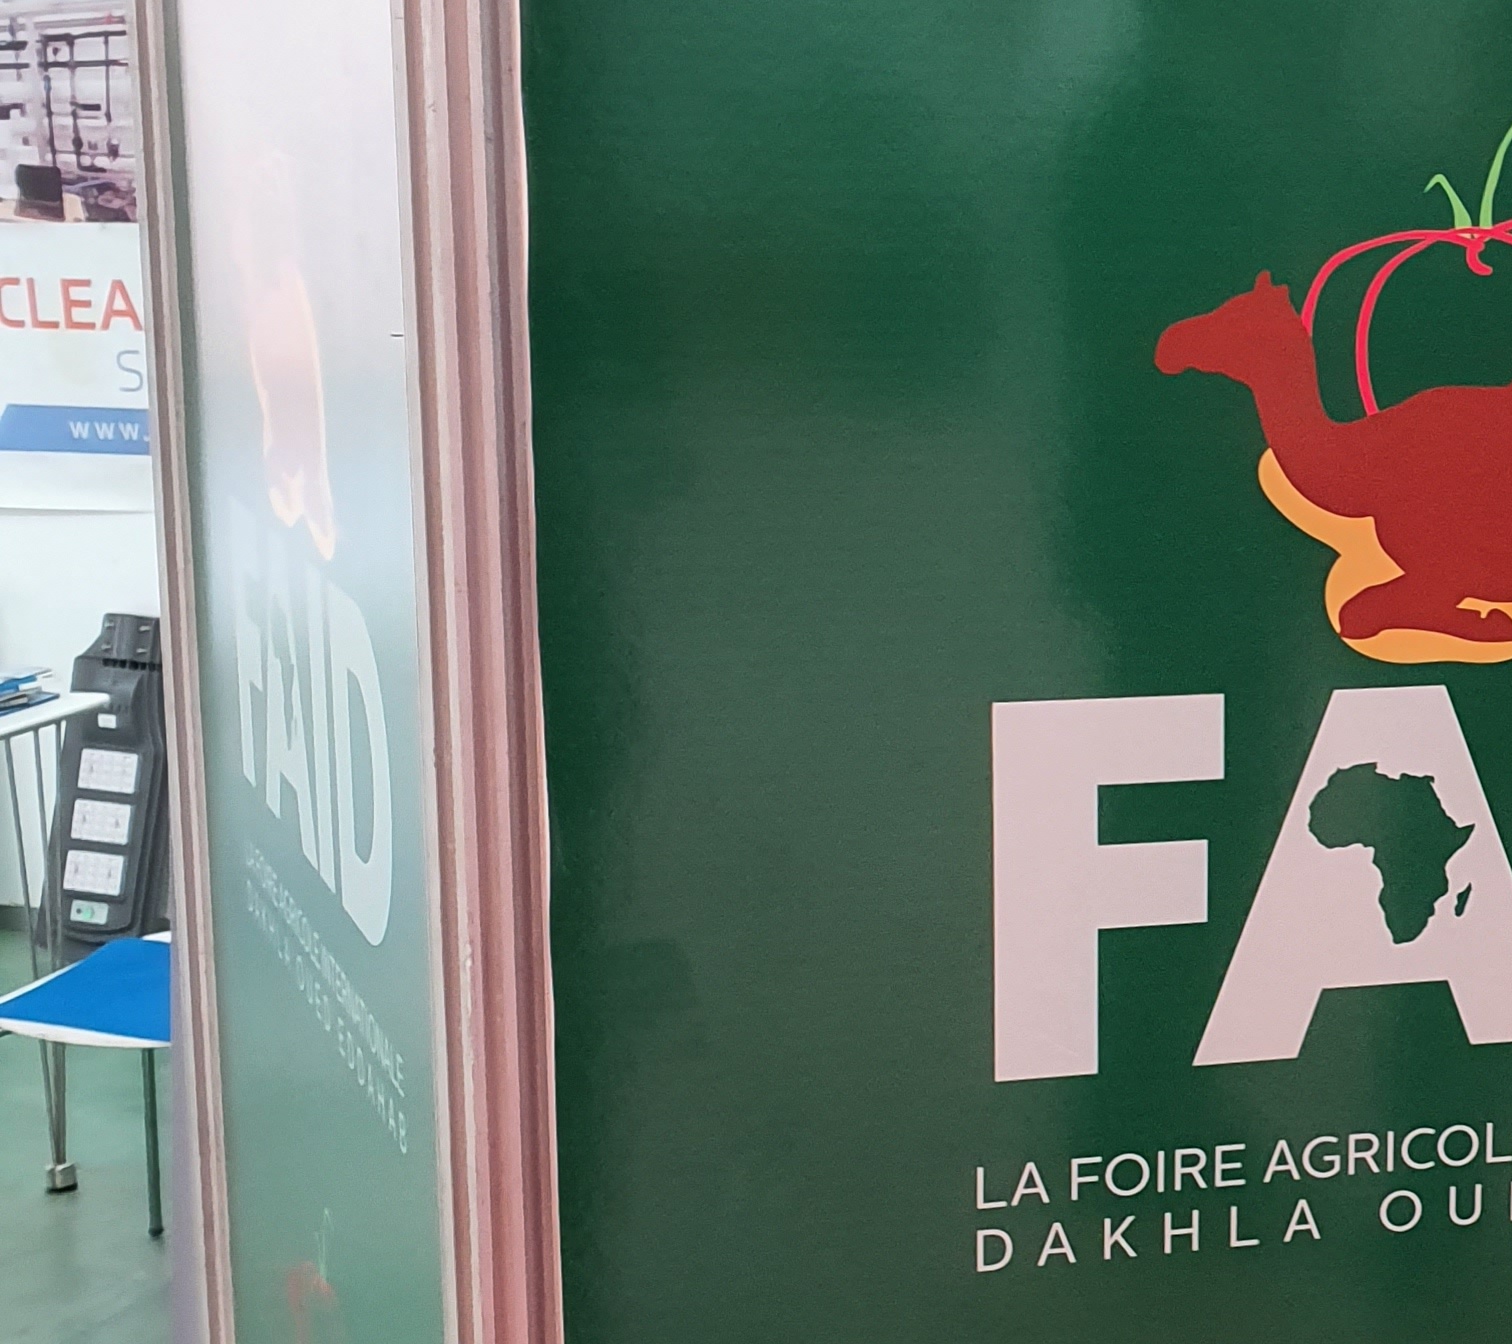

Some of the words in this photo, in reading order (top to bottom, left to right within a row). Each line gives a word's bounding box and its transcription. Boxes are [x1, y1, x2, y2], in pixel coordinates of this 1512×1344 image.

[0, 276, 144, 332] CLEA
[229, 496, 392, 947] FAID
[976, 1161, 1050, 1210] LA
[1071, 1143, 1246, 1201] FOIRE
[976, 1199, 1321, 1273] DAKHLA
